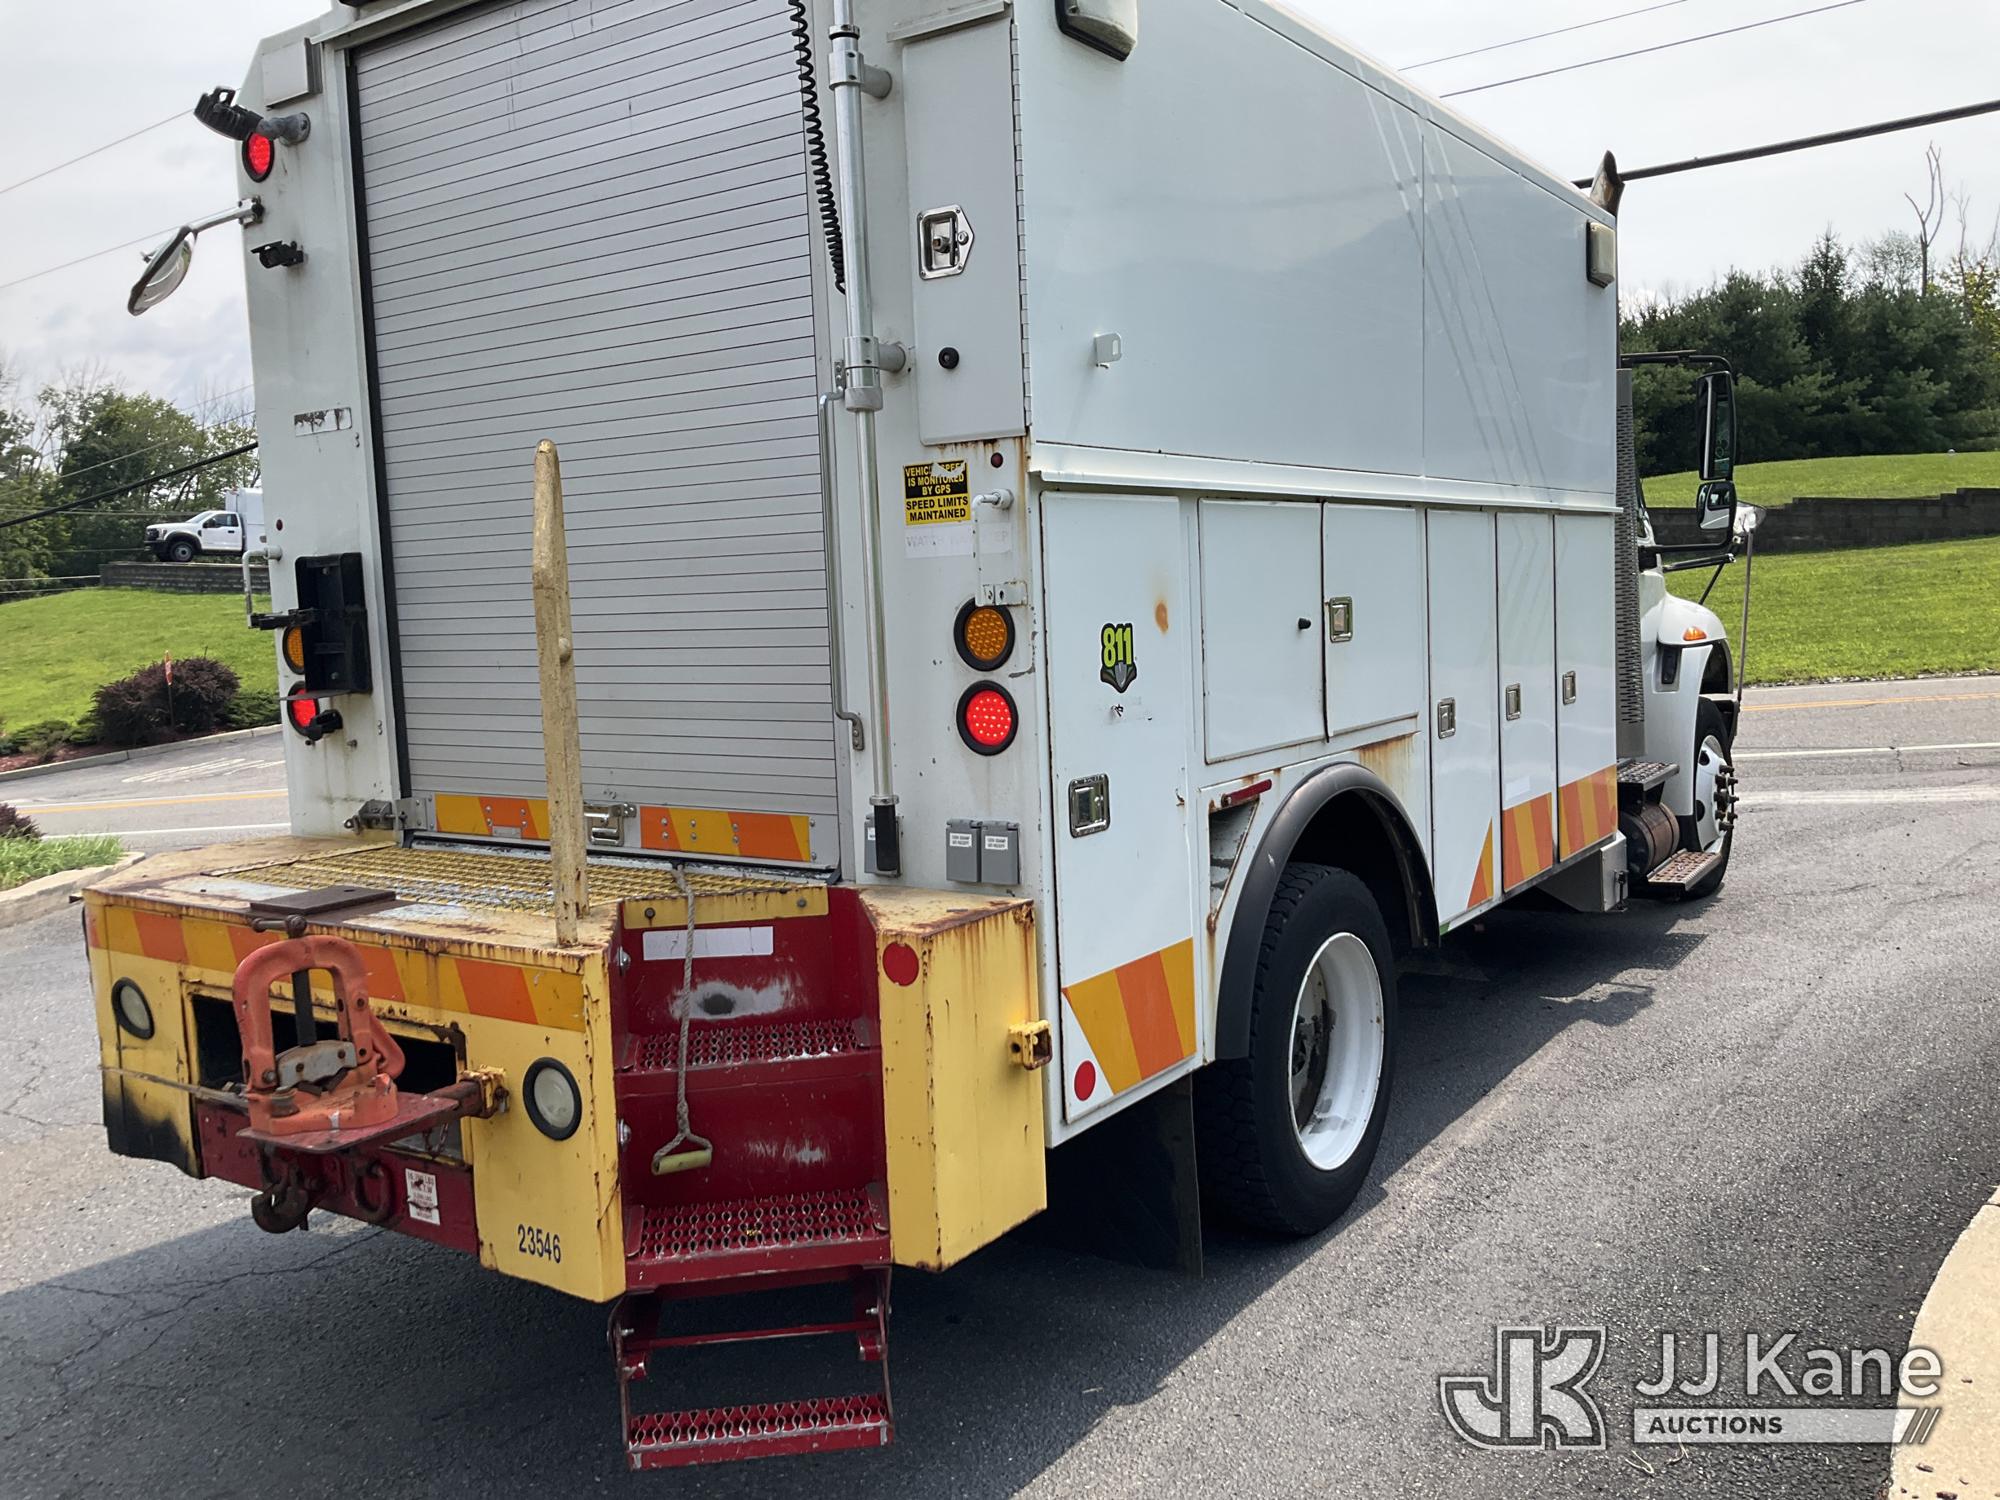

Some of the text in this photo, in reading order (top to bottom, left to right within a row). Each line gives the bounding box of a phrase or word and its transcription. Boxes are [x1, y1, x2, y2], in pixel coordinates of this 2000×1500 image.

[905, 463, 962, 477] VEHIC PEE
[908, 477, 916, 487] IS
[922, 484, 951, 496] BY GPS
[906, 496, 968, 510] SPEED LIMITS
[909, 508, 966, 521] MAINTAINED
[1102, 624, 1132, 668] 811
[517, 1223, 562, 1264] 23546
